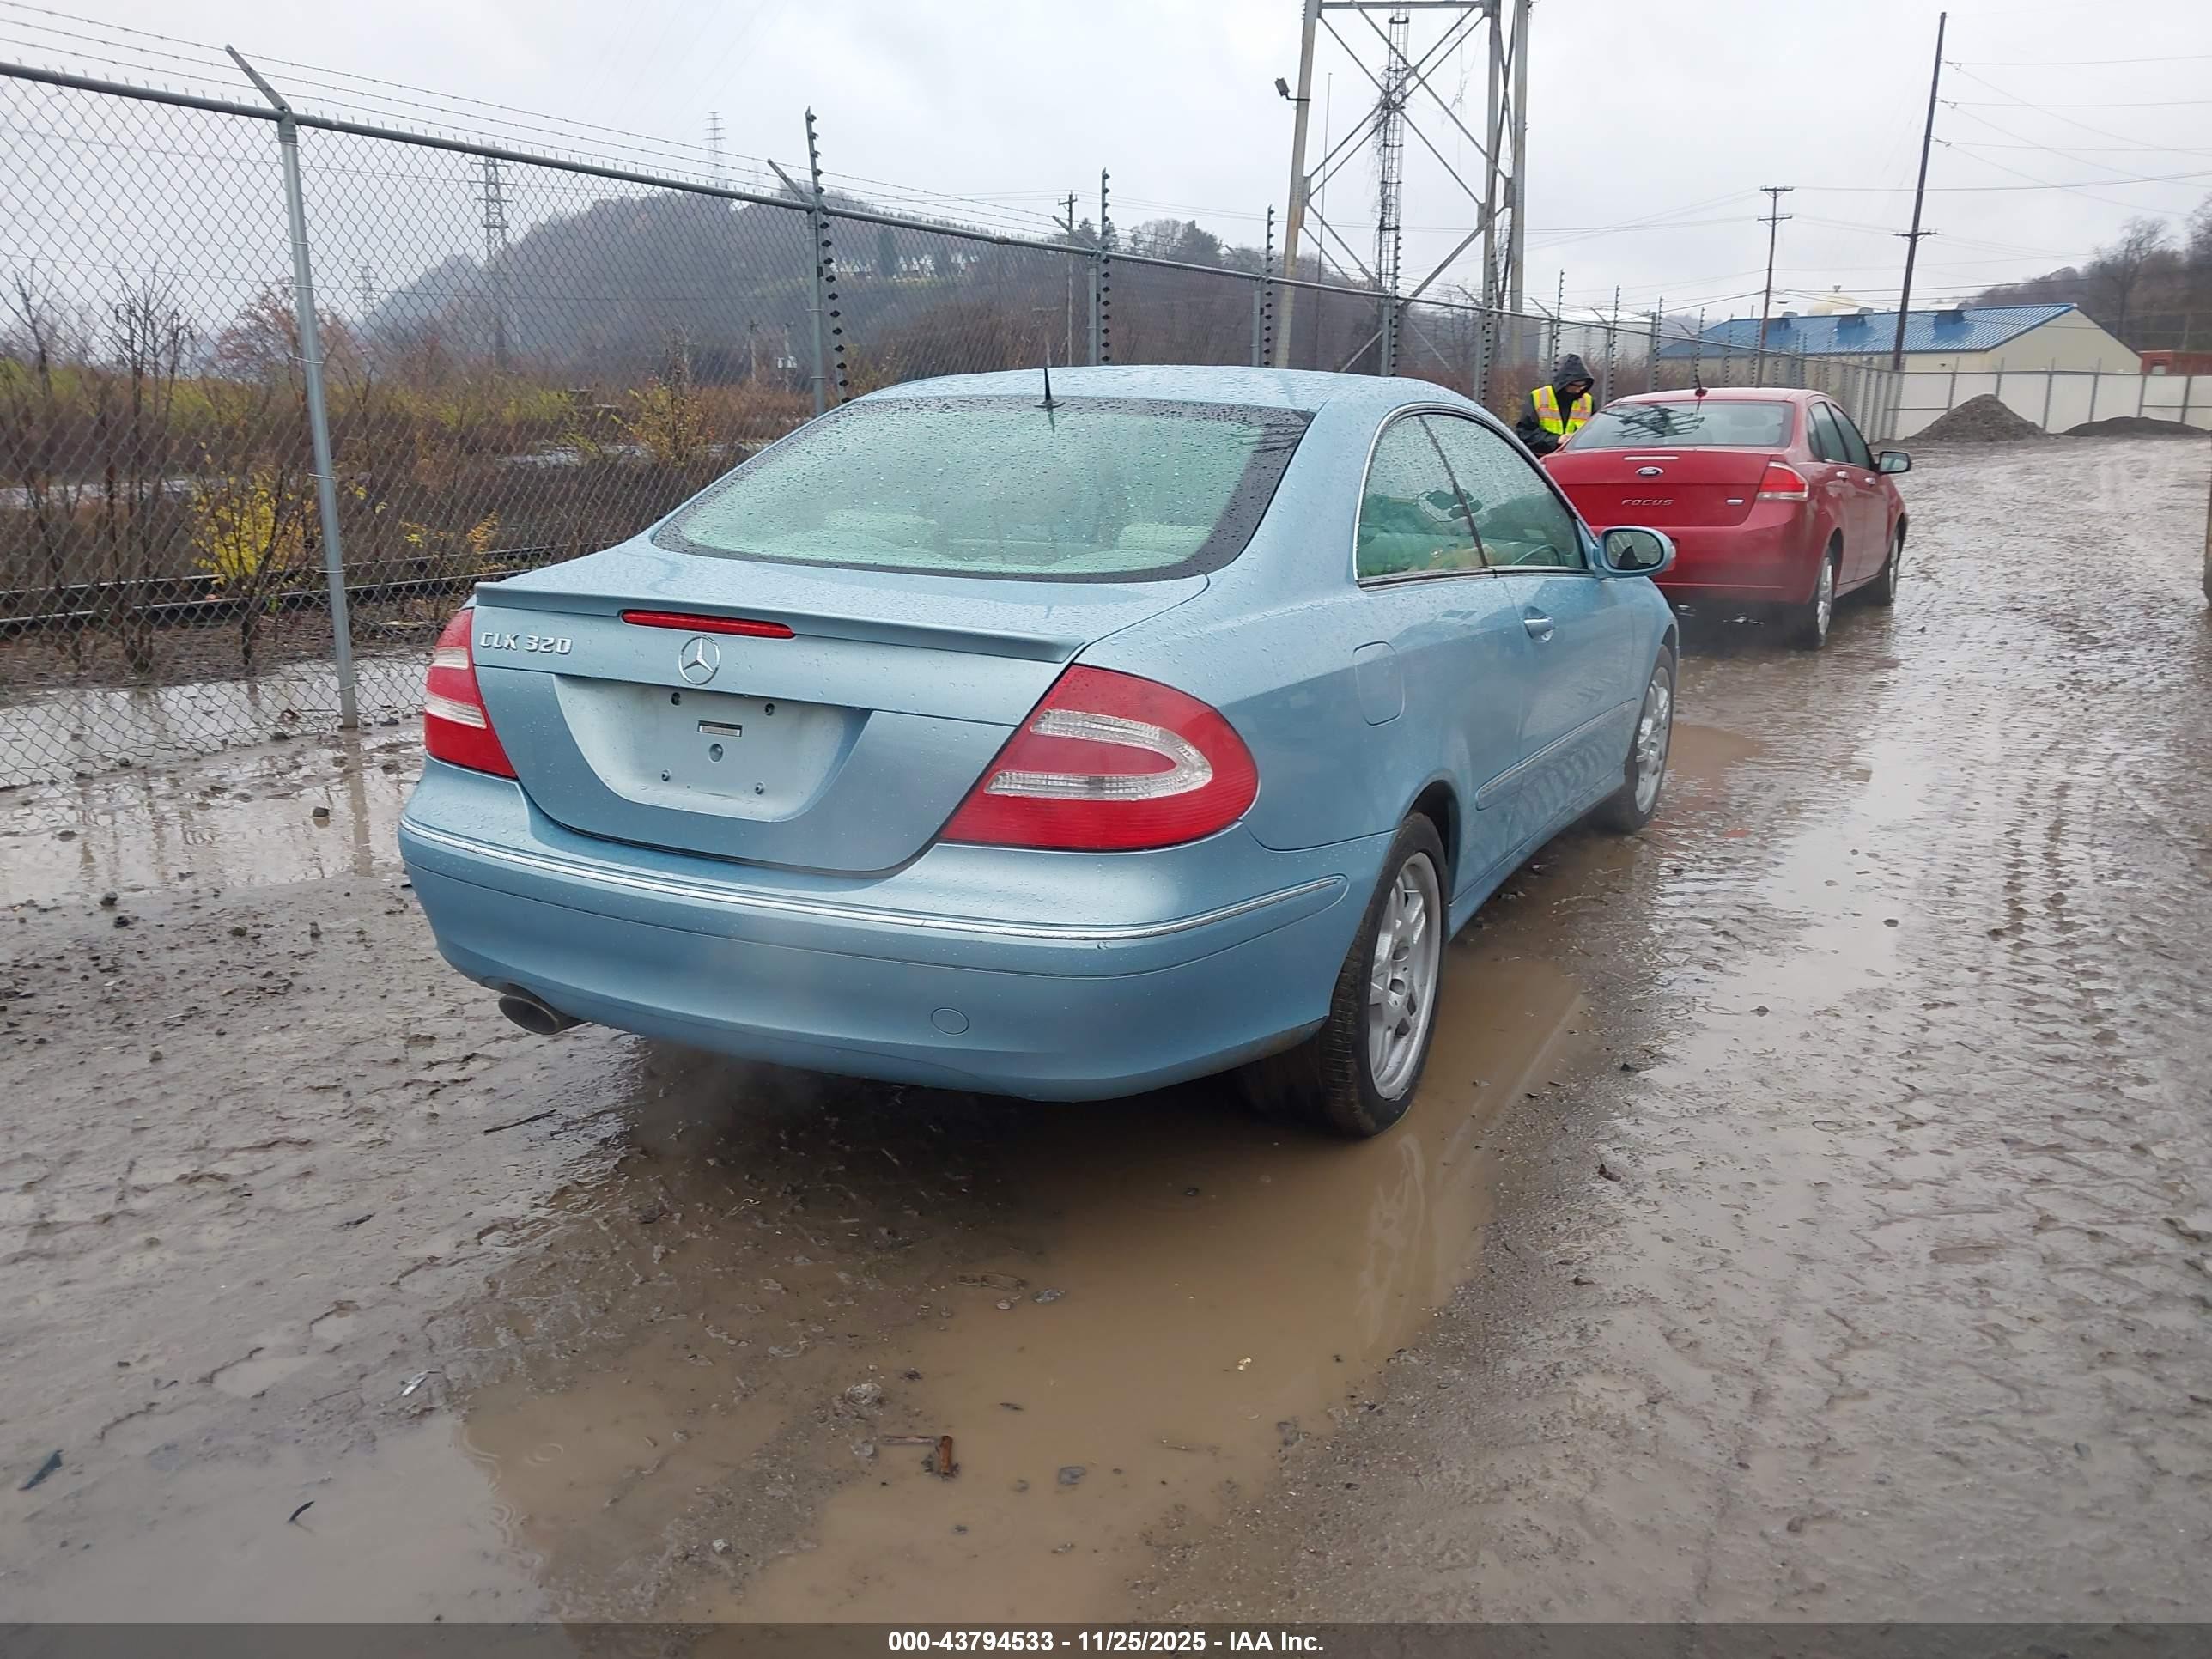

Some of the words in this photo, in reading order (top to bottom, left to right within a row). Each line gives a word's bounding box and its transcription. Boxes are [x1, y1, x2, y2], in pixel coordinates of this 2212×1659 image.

[1621, 498, 1674, 507] FOCUS
[480, 631, 520, 651] CLK
[524, 635, 573, 655] 320
